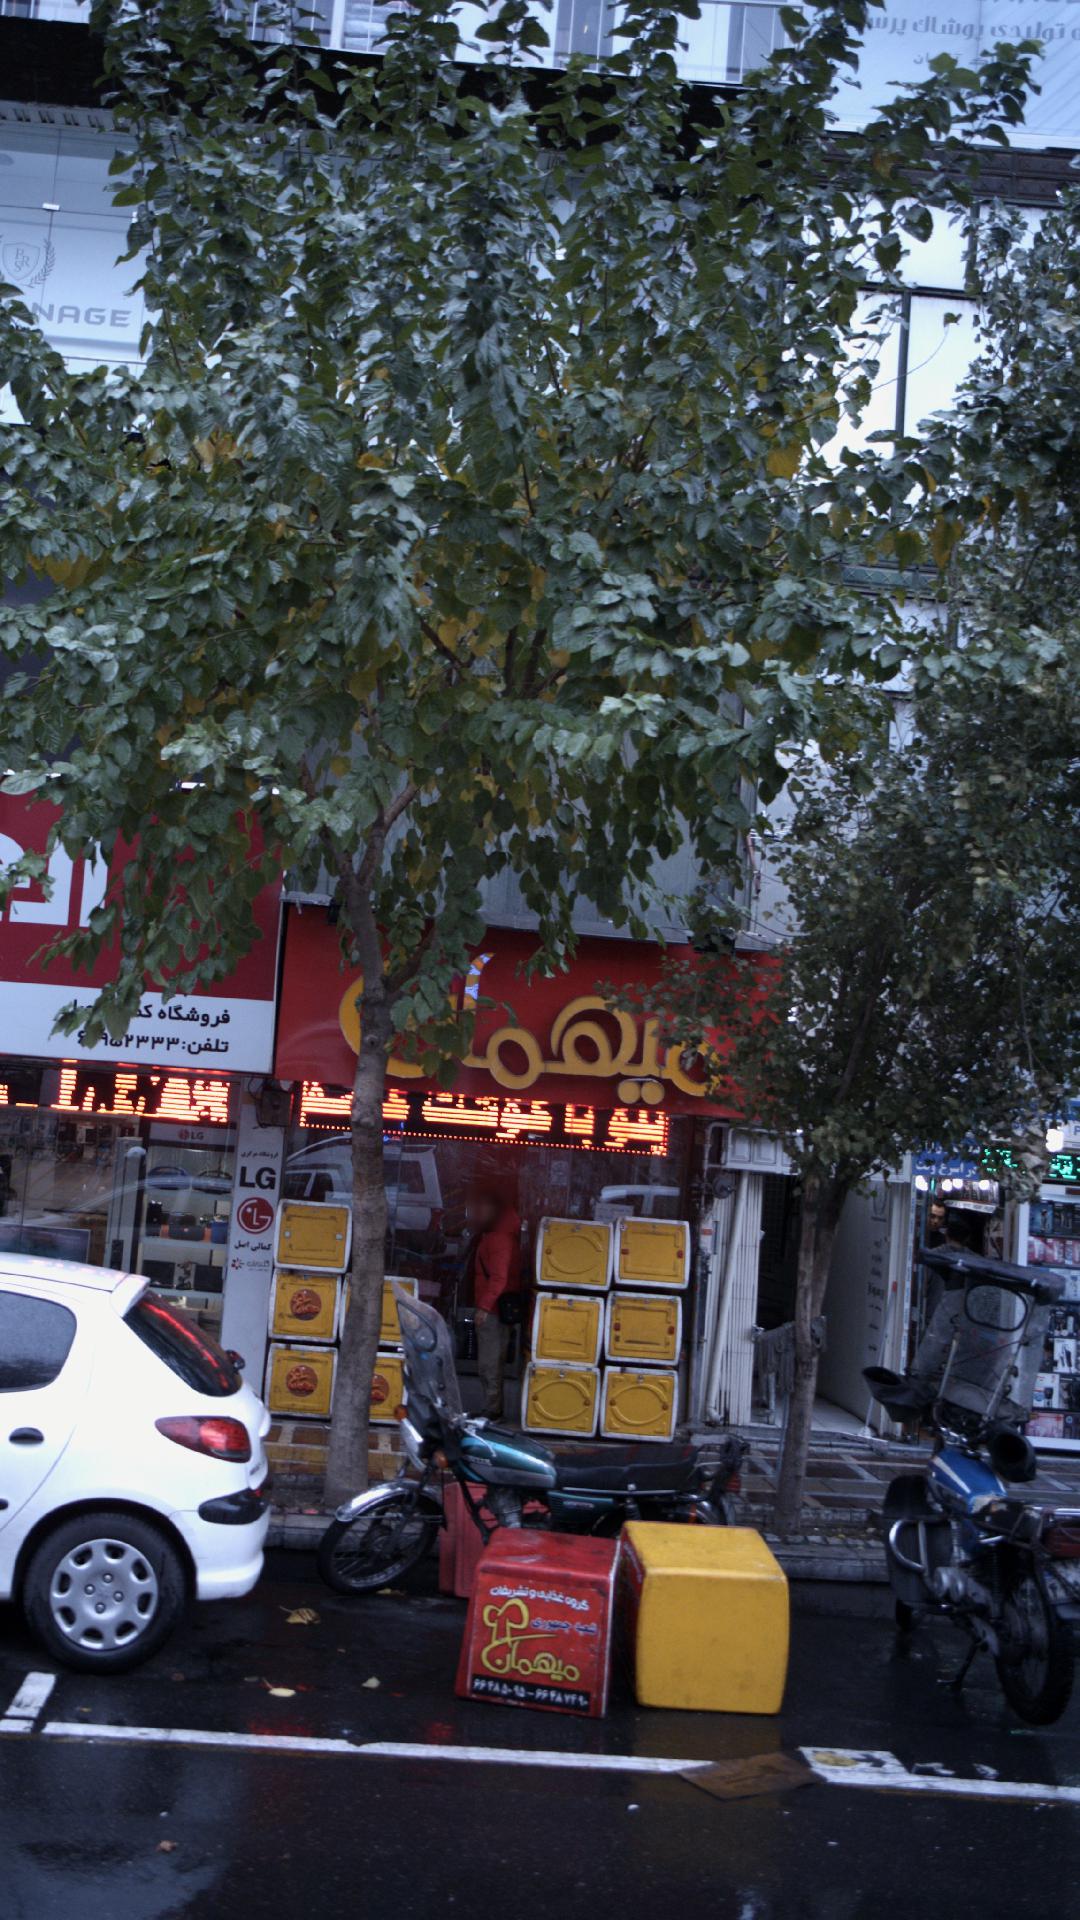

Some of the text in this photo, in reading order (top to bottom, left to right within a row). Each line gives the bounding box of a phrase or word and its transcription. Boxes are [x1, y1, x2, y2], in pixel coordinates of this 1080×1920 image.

[31, 301, 132, 328] NAGE
[158, 1005, 231, 1027] فروشگاه
[239, 1166, 277, 1190] LG
[481, 1637, 580, 1682] میهمان
